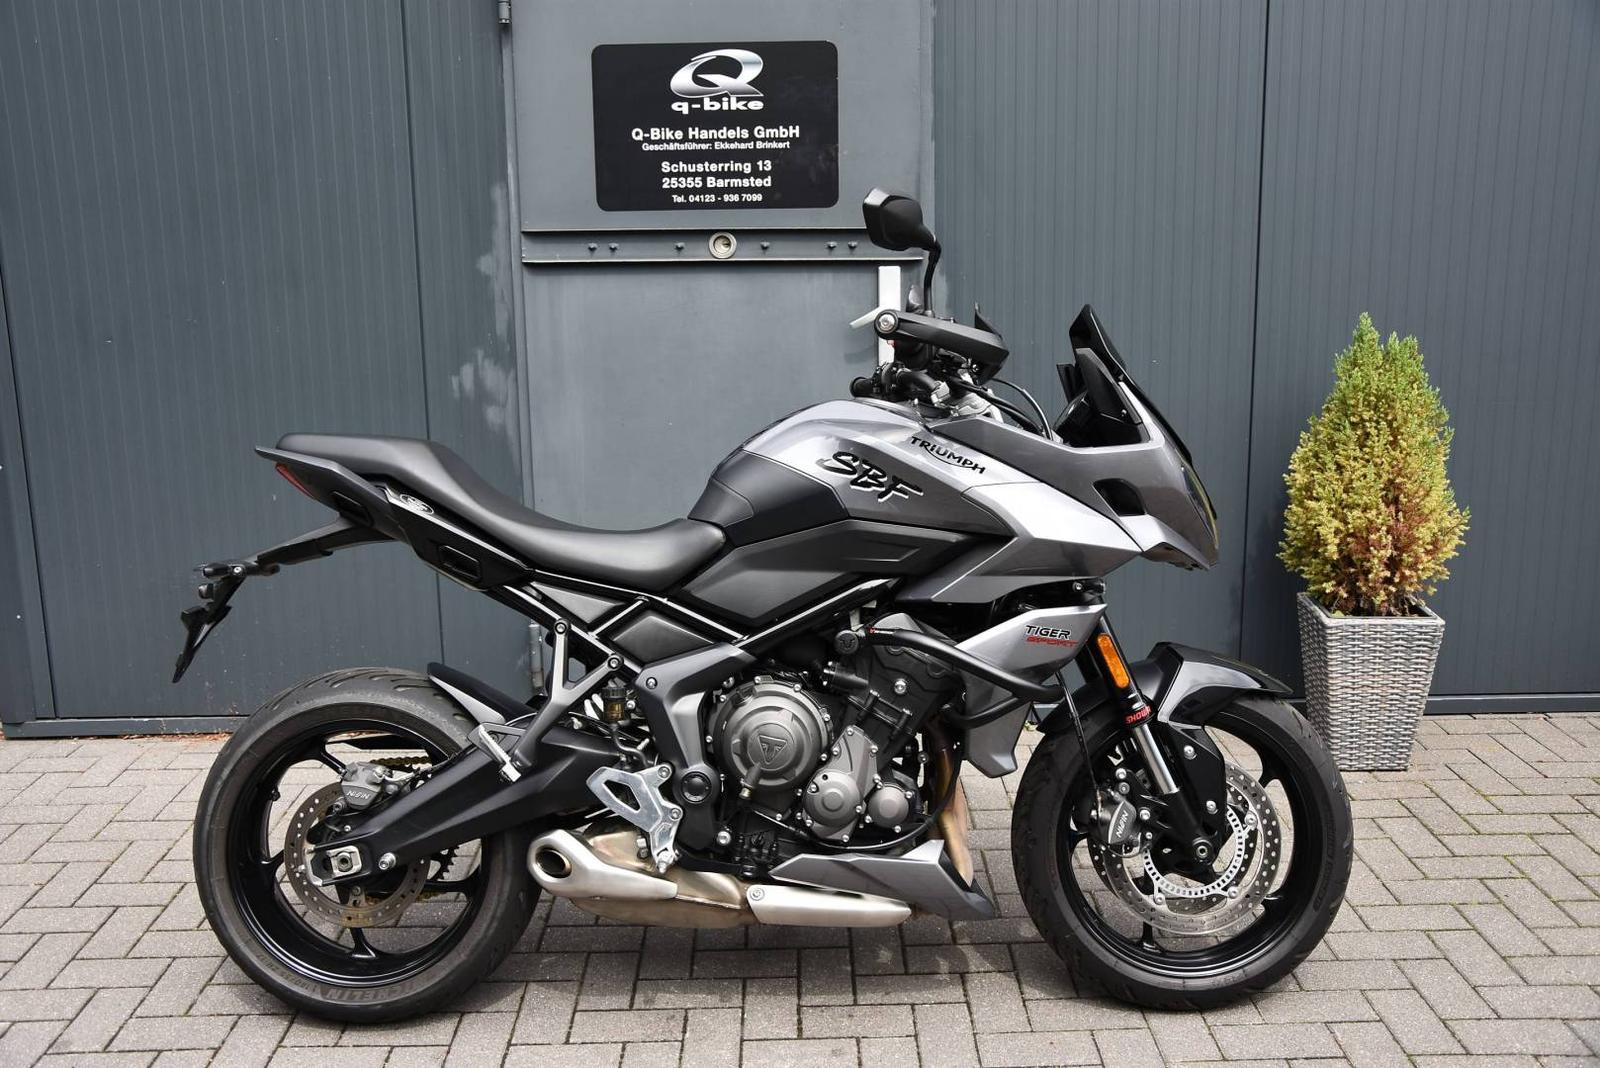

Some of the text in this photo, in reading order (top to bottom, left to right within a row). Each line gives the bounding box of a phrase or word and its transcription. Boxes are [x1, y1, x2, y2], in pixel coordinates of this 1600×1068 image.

[671, 97, 764, 115] q-bike
[631, 125, 800, 141] Q-Bike Handels GmbH
[641, 140, 790, 151] Geschäftsführer: Ekkehard Brinkert
[661, 160, 772, 174] Schusterring 13
[662, 175, 772, 189] 25355 Barmsted
[672, 194, 687, 203] Tel.
[689, 194, 716, 202] 04123
[723, 194, 740, 202] 936
[741, 193, 763, 202] 7099
[911, 436, 986, 475] TRIUMPH
[815, 451, 924, 503] SBF
[1025, 624, 1071, 640] TIGER
